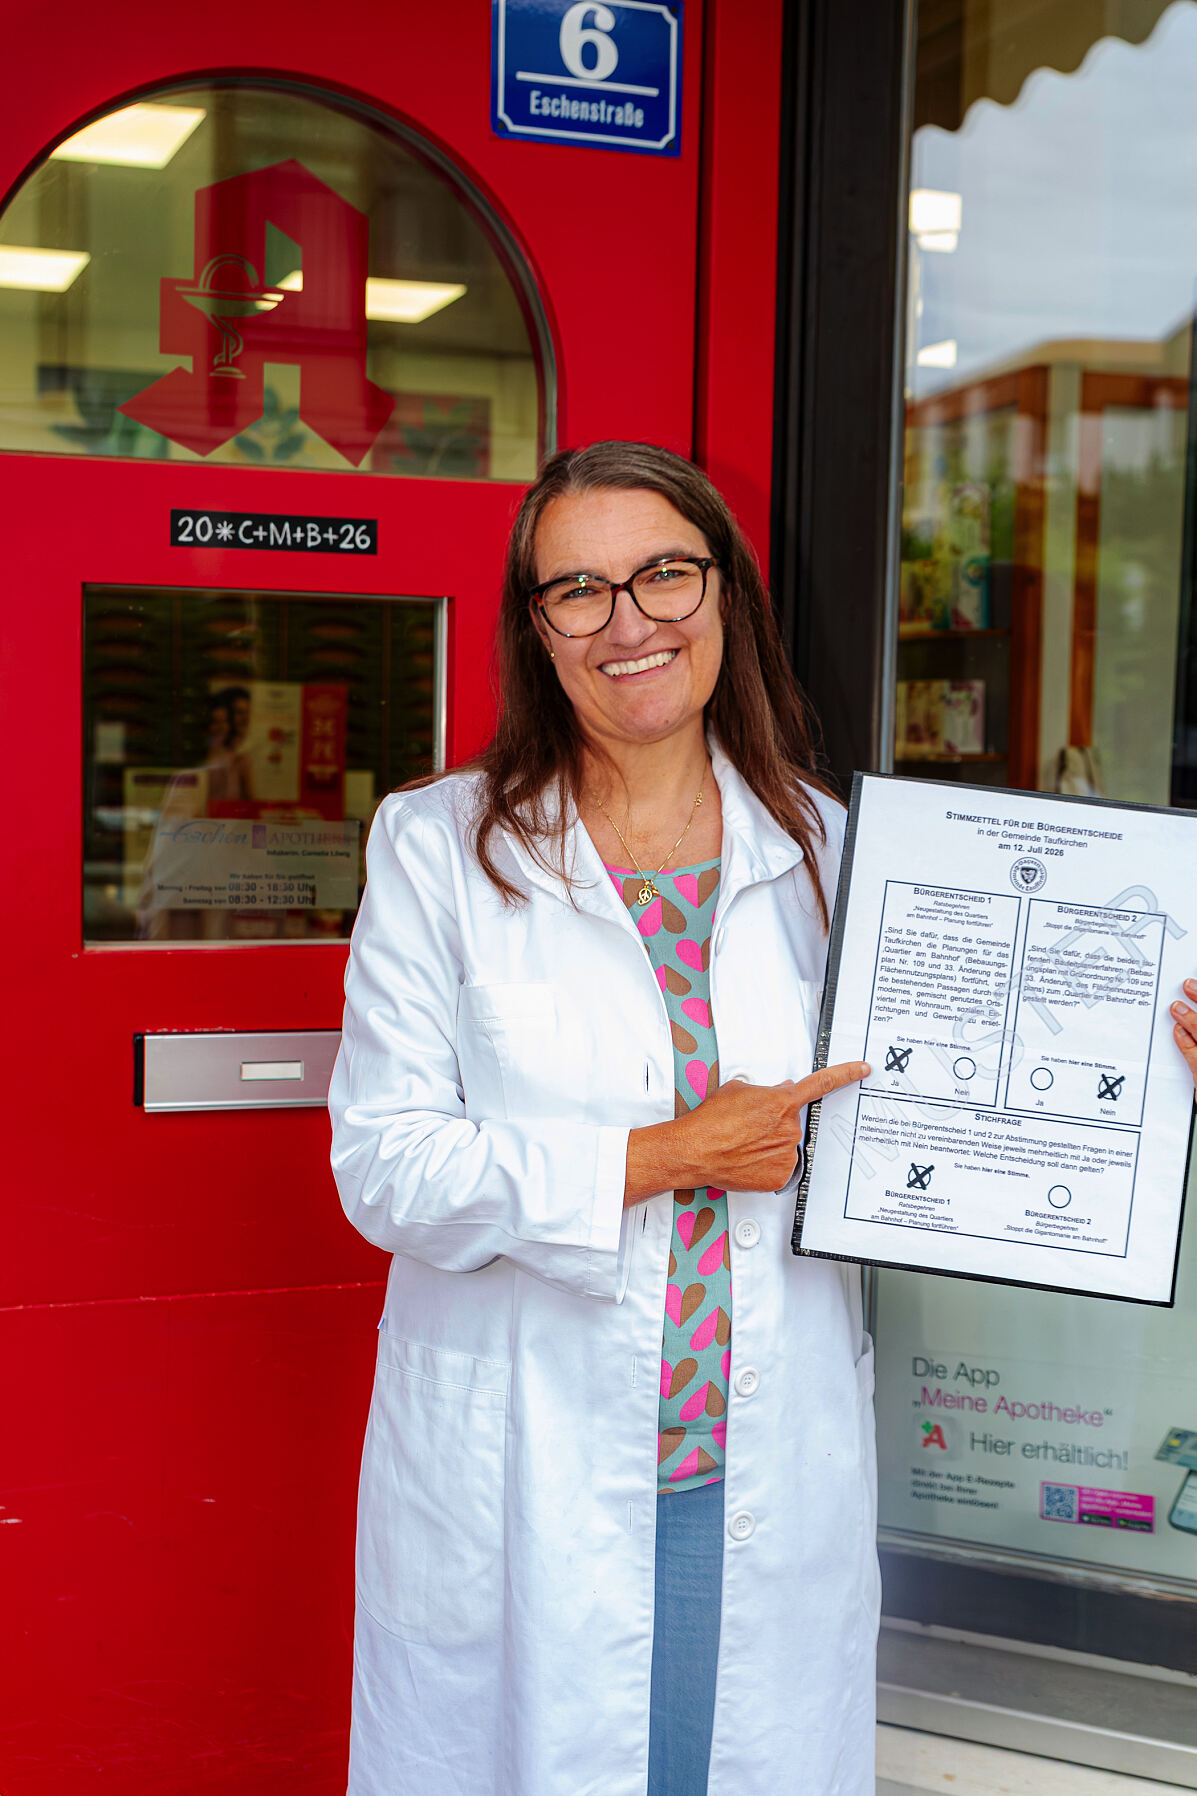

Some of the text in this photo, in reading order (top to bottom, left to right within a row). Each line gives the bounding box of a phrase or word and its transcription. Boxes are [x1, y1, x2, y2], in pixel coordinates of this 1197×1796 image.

[559, 1, 619, 81] 6
[530, 90, 644, 129] Eschenstraße
[945, 810, 1123, 841] STIMMZETTEL FÜR DIE BÜRGERENTSCHEIDE
[977, 827, 1088, 848] in der Gemeinde Taufkirchen
[1013, 843, 1025, 852] 12.
[1027, 845, 1043, 854] Juli
[1044, 847, 1064, 857] 2026
[228, 882, 257, 893] 08:30
[297, 883, 317, 894] Uhr
[913, 886, 986, 903] BÜRGERENTSCHEID
[228, 895, 257, 905] 08:30
[267, 895, 295, 905] 12:30
[297, 895, 317, 906] Uhr
[1057, 905, 1130, 922] BÜRGERENTSCHEID
[884, 935, 1009, 959] Taufkirchen die Planungen für das
[905, 928, 1011, 949] Sie dafür, dass die Gemeinde
[880, 956, 896, 964] plan
[898, 958, 908, 966] Nr.
[912, 959, 925, 968] 109
[944, 963, 955, 972] 33.
[957, 964, 991, 978] Änderung
[993, 970, 1007, 978] des
[964, 956, 1008, 969] (Bebauungs-
[879, 964, 957, 983] Flächennutzungsplans)
[961, 975, 990, 987] fortführt,
[877, 986, 1004, 1007] modernes, gemischt genutztes Orts-
[878, 975, 1005, 998] die bestehenden Passagen durch ein
[876, 994, 953, 1012] viertel mit Wohnraum,
[874, 1004, 910, 1016] richtungen
[914, 1010, 928, 1018] und
[932, 1011, 963, 1022] Gewerbe
[980, 1019, 1001, 1027] erset-
[890, 1079, 900, 1087] Ja
[954, 1088, 970, 1096] Nein
[1035, 1099, 1044, 1107] Ja
[1099, 1107, 1116, 1116] Nein
[974, 1112, 1022, 1127] STICHFRAGE
[861, 1113, 888, 1124] Werden
[888, 1118, 899, 1126] die
[900, 1119, 911, 1127] bei
[911, 1120, 967, 1135] Bürgerentscheid
[1004, 1134, 1048, 1148] Abstimmung
[1048, 1141, 1081, 1150] gestellten
[1082, 1144, 1107, 1154] Fragen
[1115, 1149, 1133, 1158] einer
[900, 1130, 917, 1139] nicht
[927, 1135, 980, 1147] vereinbarenden
[980, 1140, 1002, 1150] Weise
[1002, 1144, 1026, 1154] jeweils
[1027, 1148, 1069, 1159] mehrheitlich
[1081, 1155, 1091, 1163] Ja
[1107, 1158, 1132, 1168] jeweils
[900, 1140, 911, 1148] mit
[912, 1141, 929, 1150] Nein
[929, 1144, 971, 1156] beantwortet:
[972, 1149, 998, 1160] Welche
[999, 1153, 1046, 1168] Entscheidung
[1060, 1162, 1078, 1170] dann
[1078, 1165, 1105, 1174] gelten?
[884, 1189, 945, 1205] BÜRGERENTSCHEID
[1024, 1209, 1086, 1224] BÜRGERENTSCHEID
[912, 1357, 1000, 1389] Die App
[970, 1432, 1129, 1471] Hier erhältlich!
